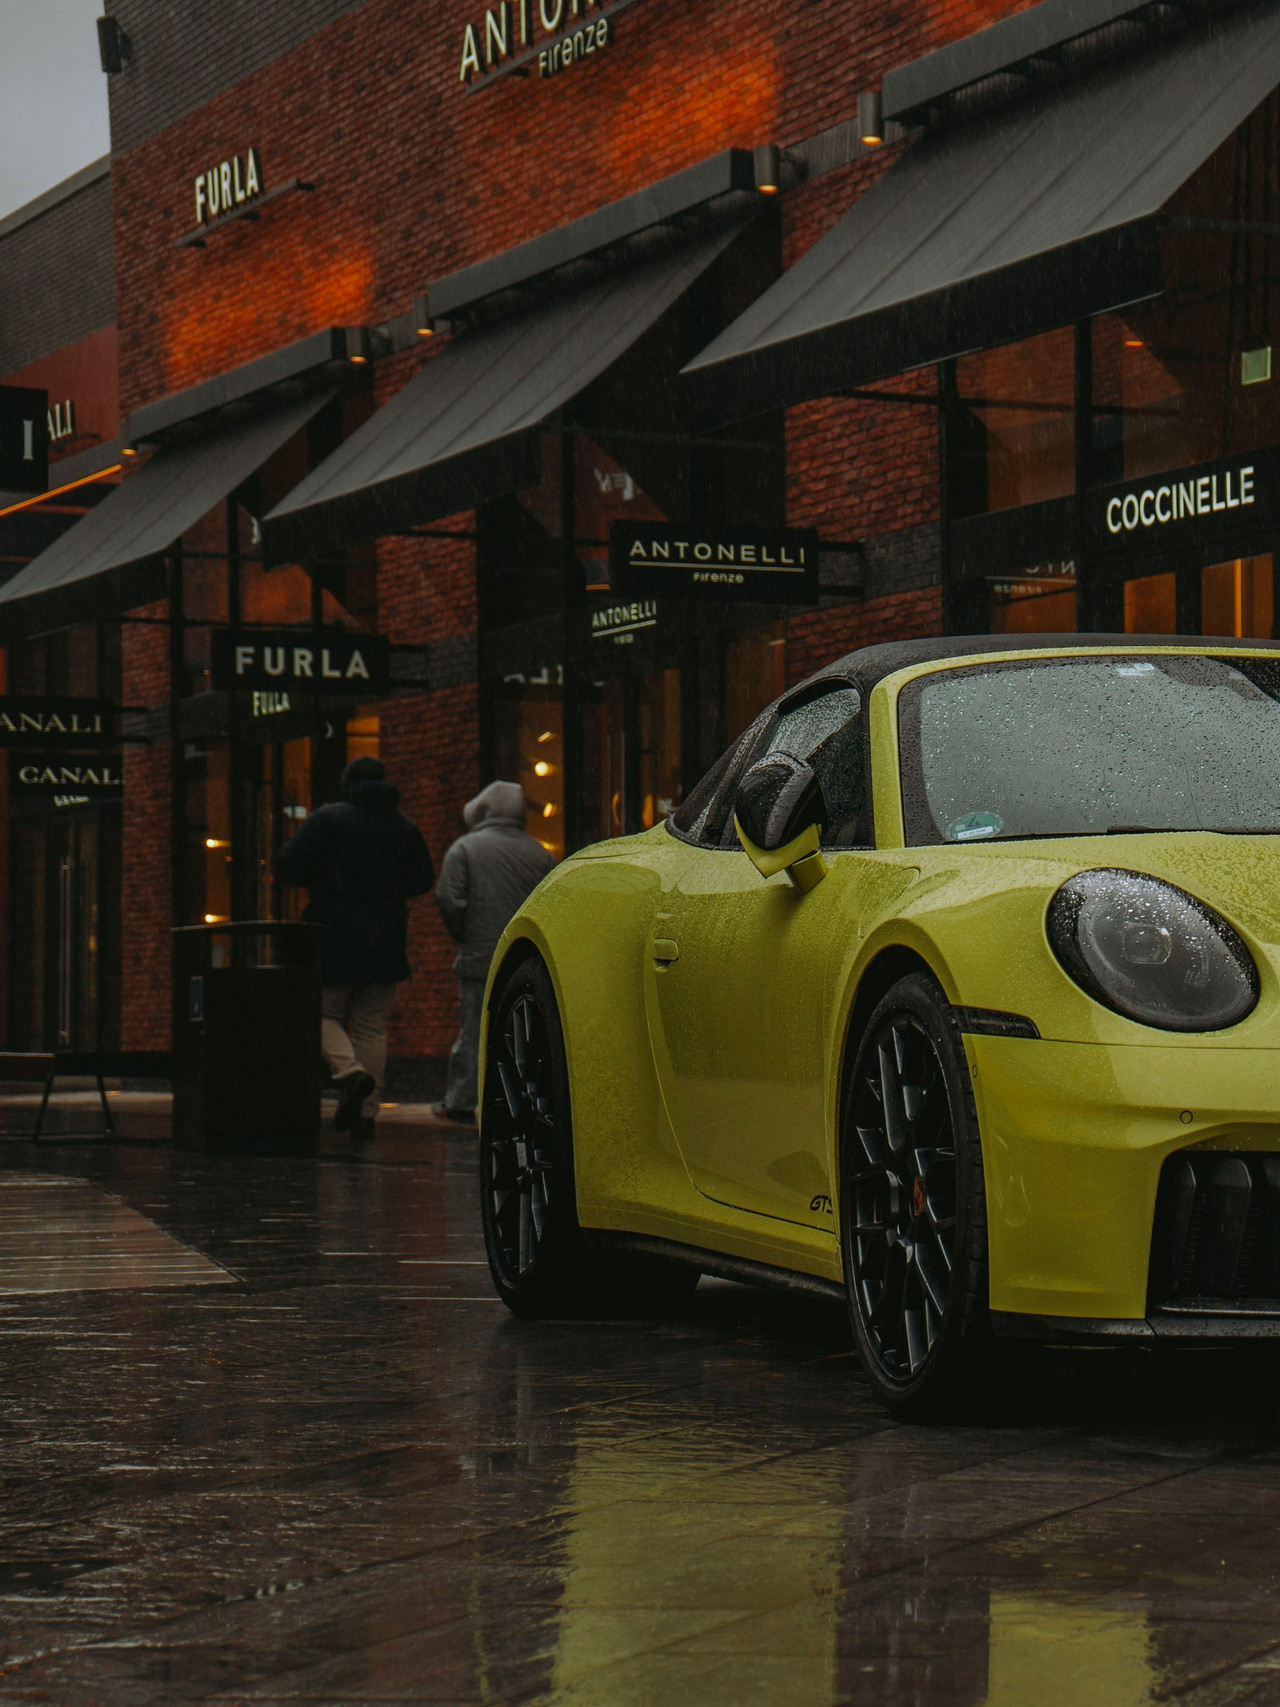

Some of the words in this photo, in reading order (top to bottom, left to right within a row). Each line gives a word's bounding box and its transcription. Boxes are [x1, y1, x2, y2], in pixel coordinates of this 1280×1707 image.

[458, 0, 596, 82] ANTO
[195, 147, 260, 223] FURLA
[1106, 465, 1256, 534] COCCINELLE
[629, 539, 805, 564] ANTONELLI
[591, 599, 657, 629] ANTONELLI
[235, 645, 370, 680] FURLA
[18, 765, 126, 785] CANAL
